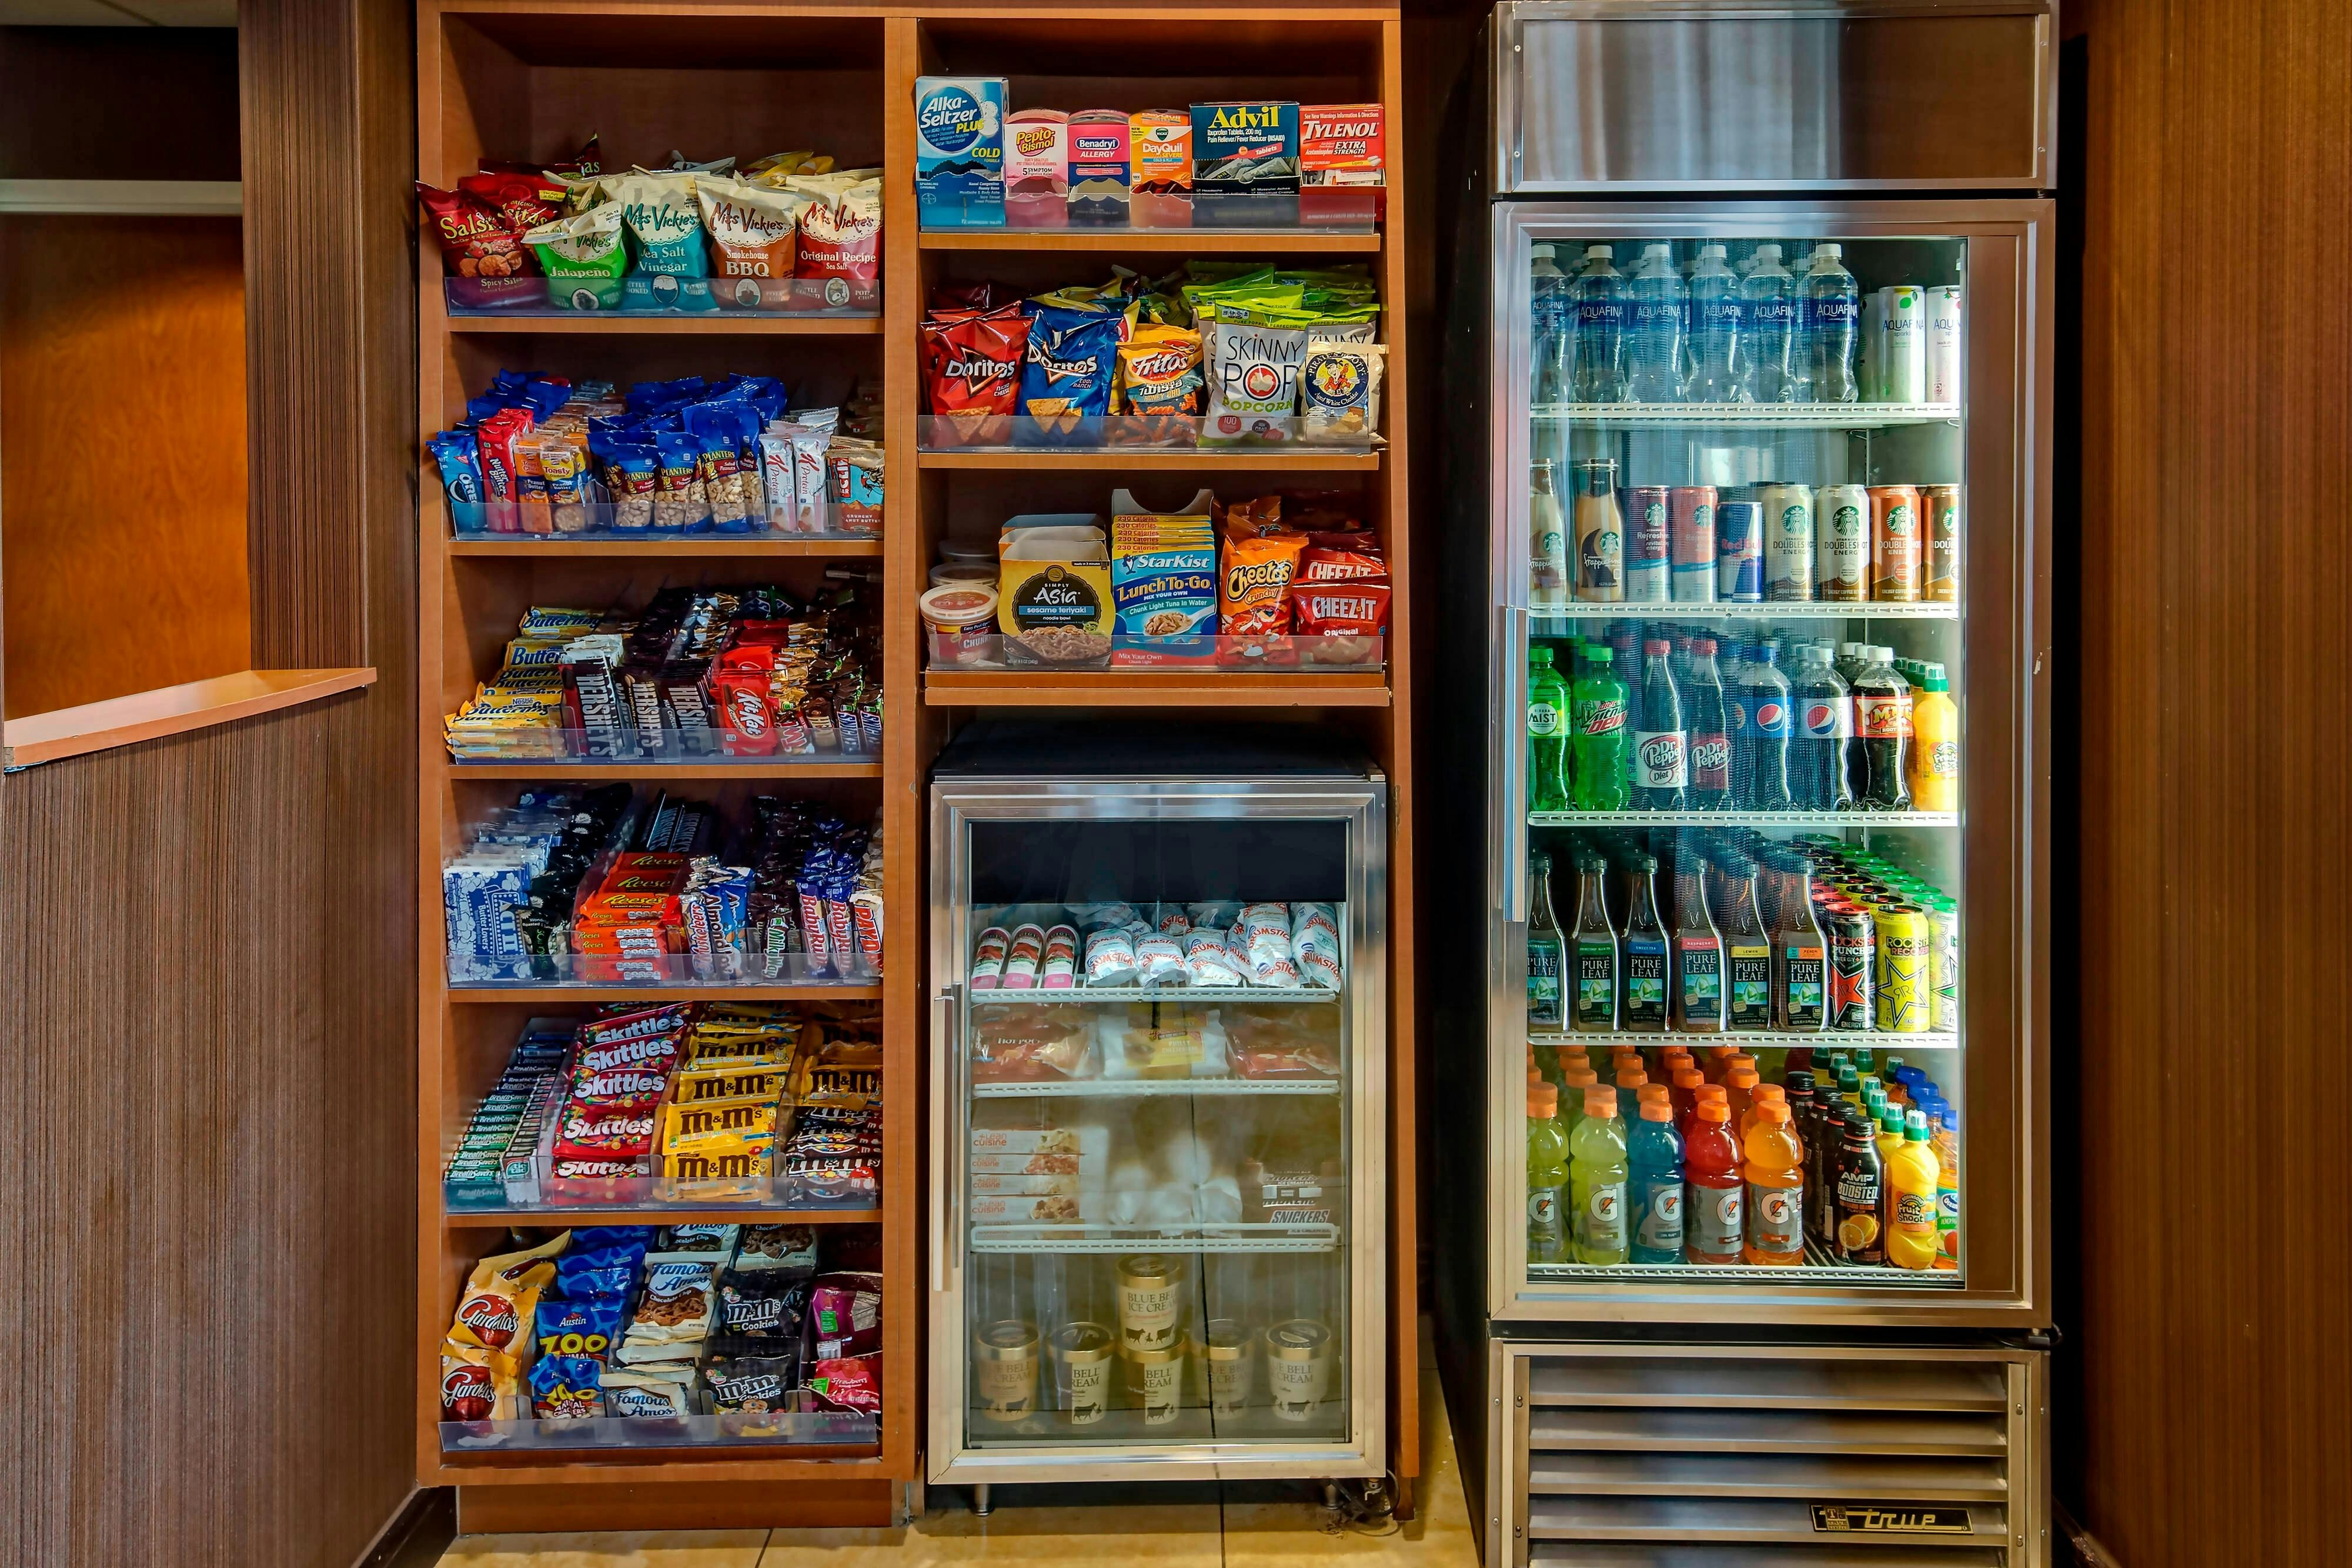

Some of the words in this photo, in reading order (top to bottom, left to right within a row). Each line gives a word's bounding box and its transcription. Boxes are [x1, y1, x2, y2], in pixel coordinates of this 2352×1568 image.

[923, 96, 967, 114] Alka-
[920, 108, 977, 128] Seltzer
[1208, 106, 1279, 129] Advil
[956, 118, 985, 133] PLUS
[1302, 121, 1378, 141] TYLENOL
[1016, 129, 1055, 145] Pepto-
[1021, 138, 1054, 153] Bismol
[1080, 140, 1115, 149] Benadryl
[1142, 143, 1182, 155] DayQuil
[1255, 145, 1277, 155] Tablets
[972, 148, 1000, 158] COLD
[652, 203, 698, 232] Vickie's
[740, 208, 786, 236] Vickie's
[834, 204, 875, 233] Vickie's
[662, 246, 685, 258] Salt
[727, 249, 769, 260] Smokehouse
[801, 250, 839, 262] Original
[841, 251, 876, 262] Recipe
[550, 266, 610, 278] Jalapeño
[639, 261, 687, 272] Vinegar
[726, 261, 770, 277] BBQ
[836, 262, 847, 270] Salt
[481, 279, 501, 287] Spicy
[1580, 306, 1623, 319] AQUAFINA
[1637, 305, 1681, 319] AQUAFINA
[1027, 346, 1097, 375] Doritos
[1132, 352, 1188, 376] Fritos
[946, 359, 1015, 377] Doritos
[1223, 363, 1299, 401] POP
[1222, 396, 1293, 412] POPCORN
[1315, 393, 1325, 403] Aged
[1341, 392, 1358, 404] Cheddar
[702, 452, 734, 462] PLANTERS
[766, 454, 789, 473] K
[799, 453, 820, 472] K
[489, 458, 509, 483] Nutter
[489, 470, 507, 495] Butter
[770, 468, 780, 496] Protein
[800, 466, 810, 494] Protein
[1137, 554, 1210, 569] StarKist
[1228, 561, 1292, 599] Cheetos
[1034, 587, 1080, 605] Asia
[1118, 577, 1166, 602] Lunch
[1245, 589, 1278, 604] Crunchy
[1058, 606, 1086, 614] teriyaki
[1130, 606, 1147, 615] Chunk
[1149, 601, 1164, 610] Light
[737, 691, 761, 714] Kit
[737, 710, 764, 735] Kat
[1529, 713, 1556, 723] MIST
[1660, 741, 1674, 753] Dr
[1707, 742, 1722, 754] Dr
[1648, 744, 1683, 767] Pepper
[1696, 747, 1729, 767] Pepper
[1654, 771, 1668, 781] Diet
[478, 905, 487, 928] Butter
[480, 928, 489, 951] Lovers
[1528, 958, 1556, 967] PURE
[1582, 960, 1609, 969] PURE
[1632, 959, 1661, 968] PURE
[1686, 954, 1716, 964] PURE
[1582, 969, 1607, 978] LEAF
[1632, 968, 1659, 977] LEAF
[1686, 964, 1714, 972] LEAF
[1736, 963, 1765, 972] PURE
[1791, 964, 1819, 973] PURE
[1736, 972, 1763, 981] LEAF
[1792, 973, 1818, 982] LEAF
[595, 1014, 683, 1042] Skittles
[583, 1039, 674, 1072] Skittles
[574, 1073, 665, 1098] Skittles
[693, 1074, 773, 1100] m&m's
[680, 1107, 762, 1135] m&m's
[564, 1118, 653, 1139] Skittles
[452, 1170, 494, 1178] BreathSavers
[1840, 1172, 1875, 1181] AMP
[1838, 1183, 1878, 1199] BOOSTED
[1591, 1189, 1618, 1222] G
[1761, 1192, 1790, 1225] G
[1897, 1203, 1921, 1215] Fruit
[1271, 1210, 1329, 1223] SNICKERS
[1897, 1213, 1924, 1223] Shoot
[653, 1263, 712, 1276] Famous
[656, 1276, 711, 1292] Amos
[1128, 1292, 1155, 1303] BLUE
[1128, 1302, 1143, 1312] ICE
[559, 1318, 586, 1328] Austin
[741, 1320, 779, 1330] Cookies
[540, 1334, 609, 1355] ZOO
[1074, 1368, 1099, 1378] BELL
[1146, 1368, 1172, 1379] BELL
[1287, 1365, 1313, 1373] BELL
[617, 1393, 669, 1406] Famous
[739, 1388, 781, 1400] Cookies
[626, 1406, 676, 1416] Amos
